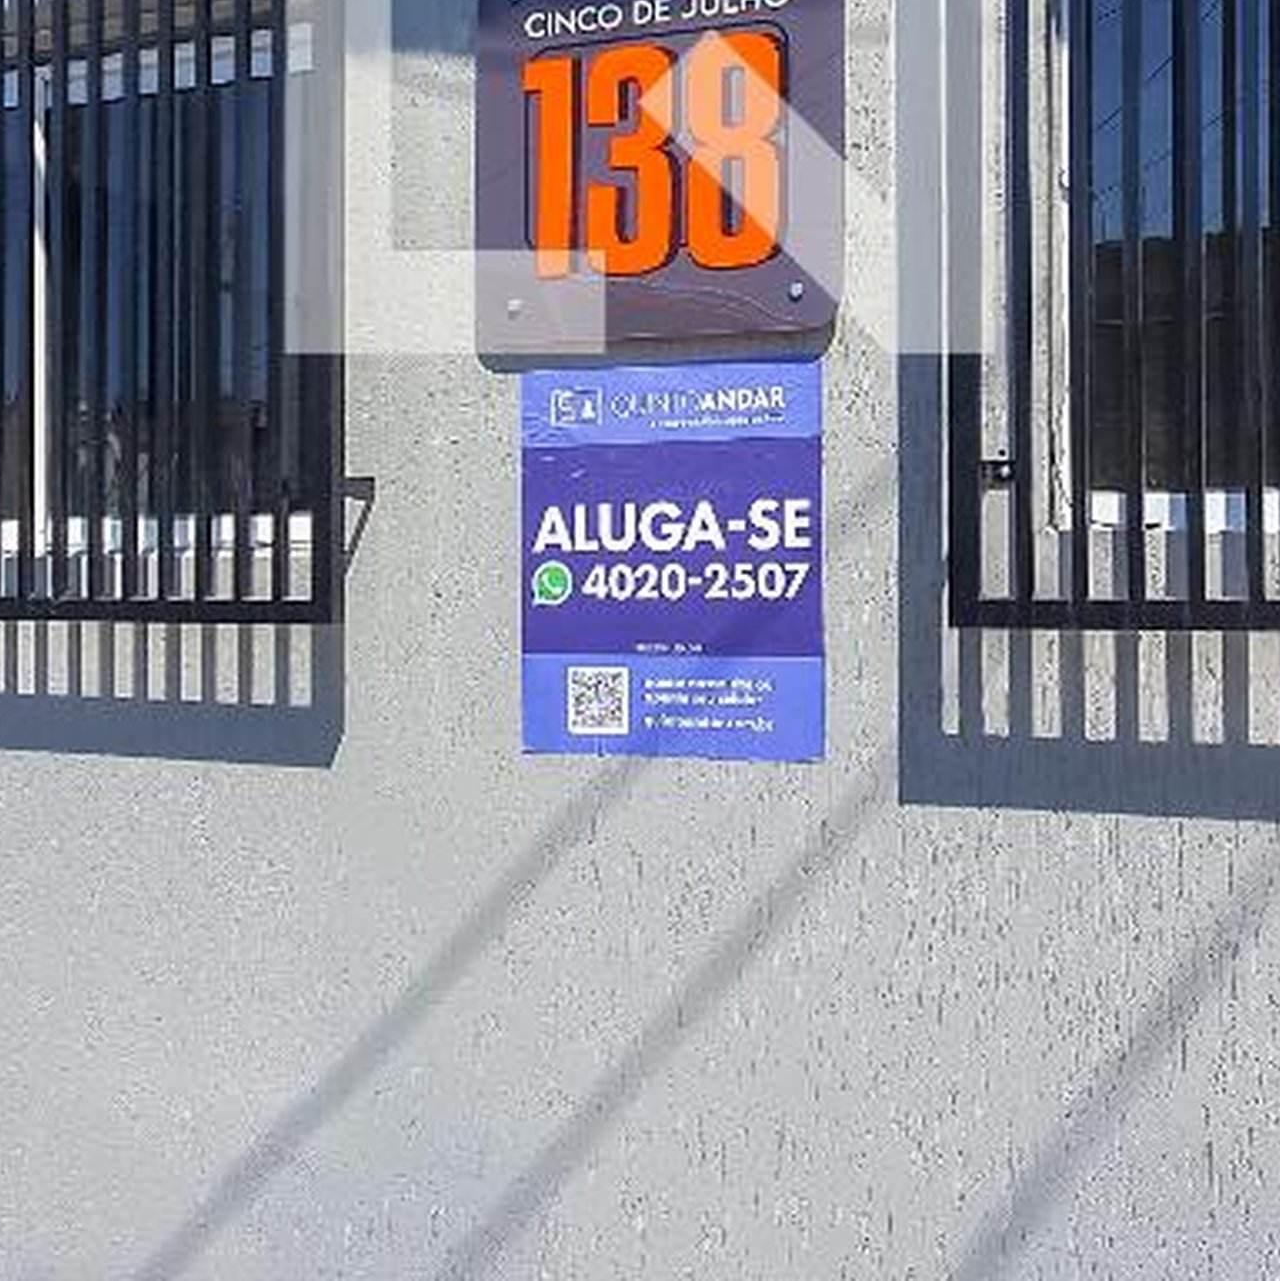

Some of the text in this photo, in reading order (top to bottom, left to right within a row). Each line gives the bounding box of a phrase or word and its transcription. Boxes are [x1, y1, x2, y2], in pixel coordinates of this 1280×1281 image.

[524, 5, 622, 39] CINCO
[523, 31, 787, 281] 138
[532, 499, 812, 554] ALUGA-SE
[582, 563, 811, 601] 4020-2507
